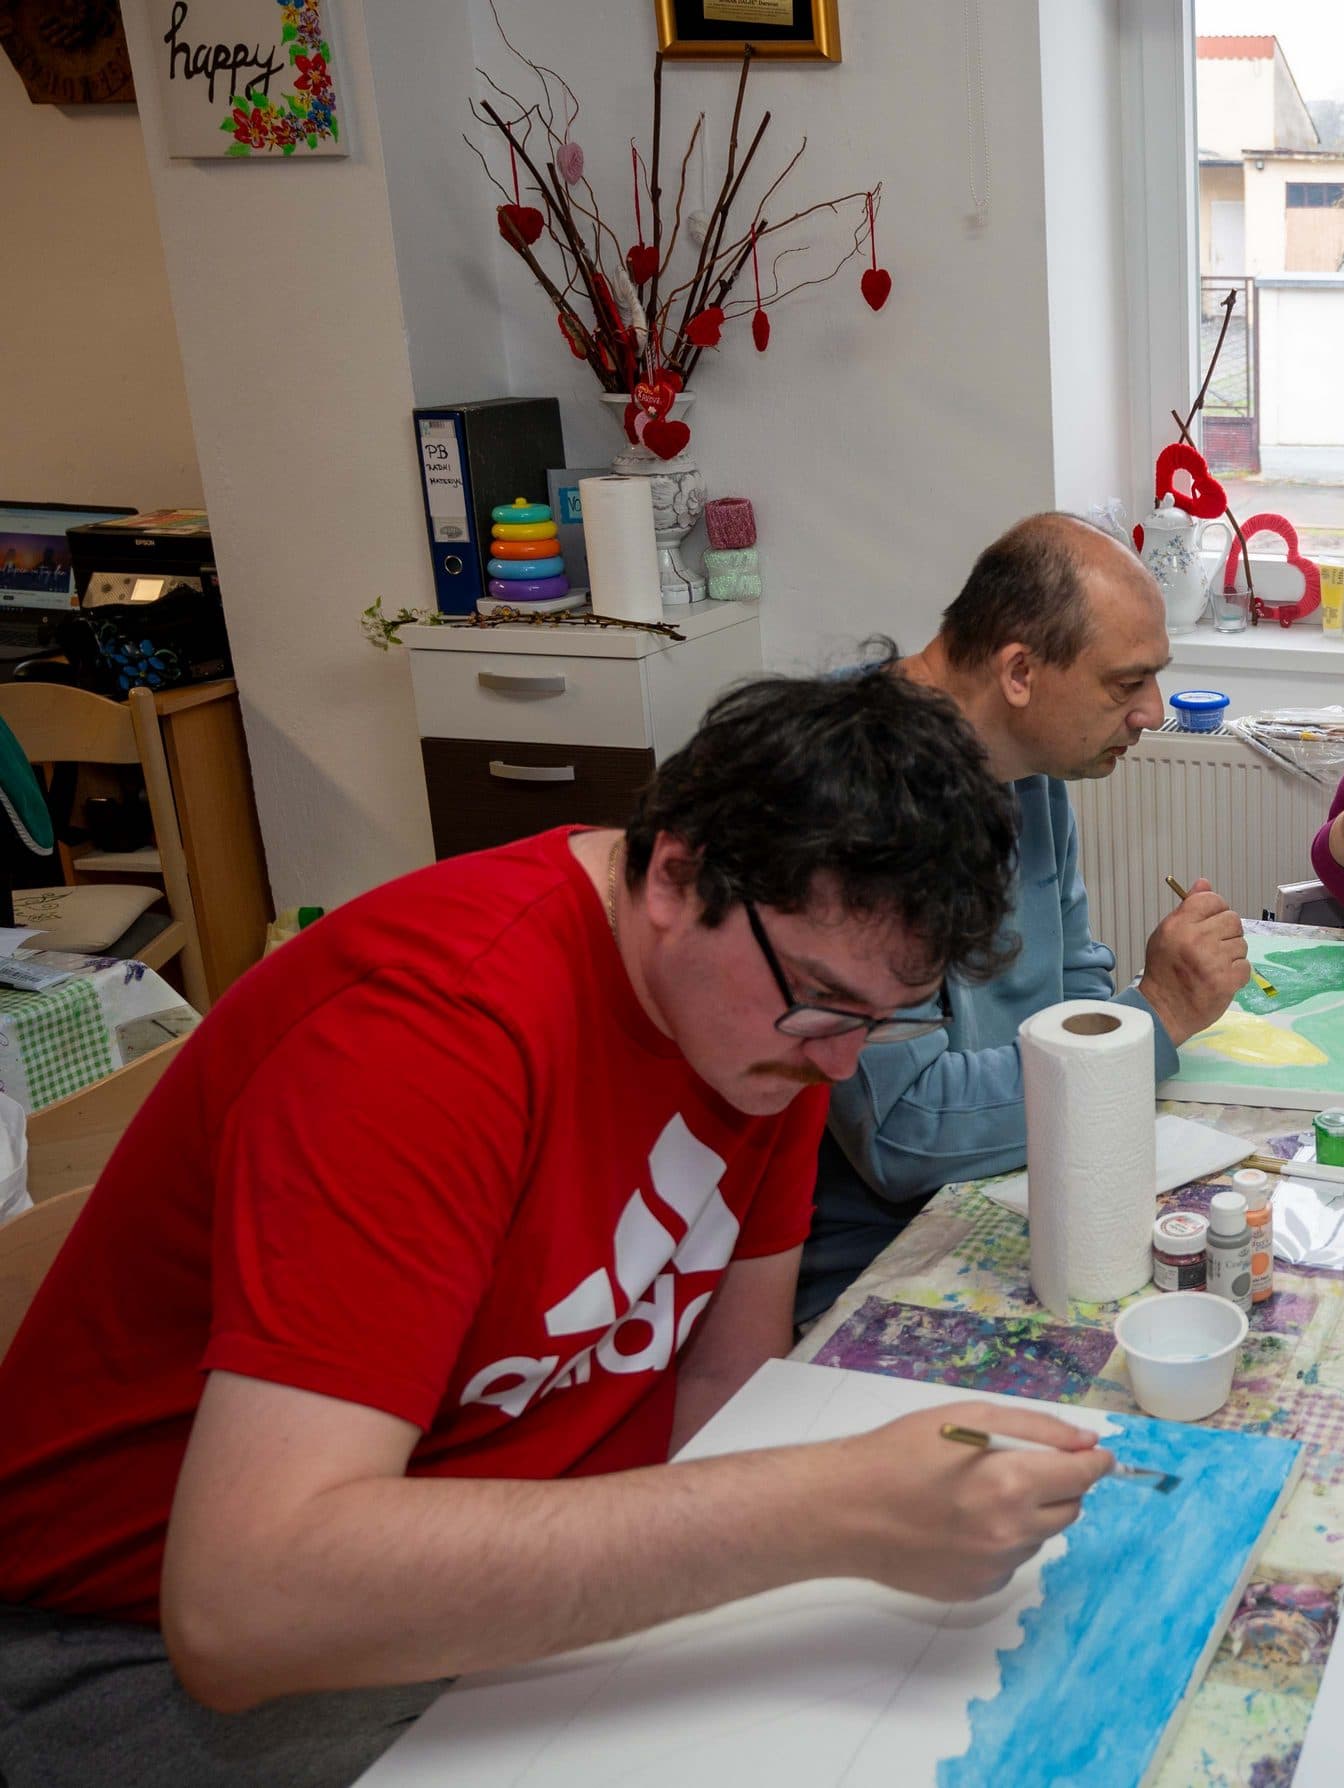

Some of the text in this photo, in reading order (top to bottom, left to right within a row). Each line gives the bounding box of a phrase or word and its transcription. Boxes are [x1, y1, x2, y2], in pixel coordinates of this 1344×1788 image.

[164, 1, 284, 106] happy
[425, 444, 449, 459] PB
[135, 538, 155, 546] EPSON
